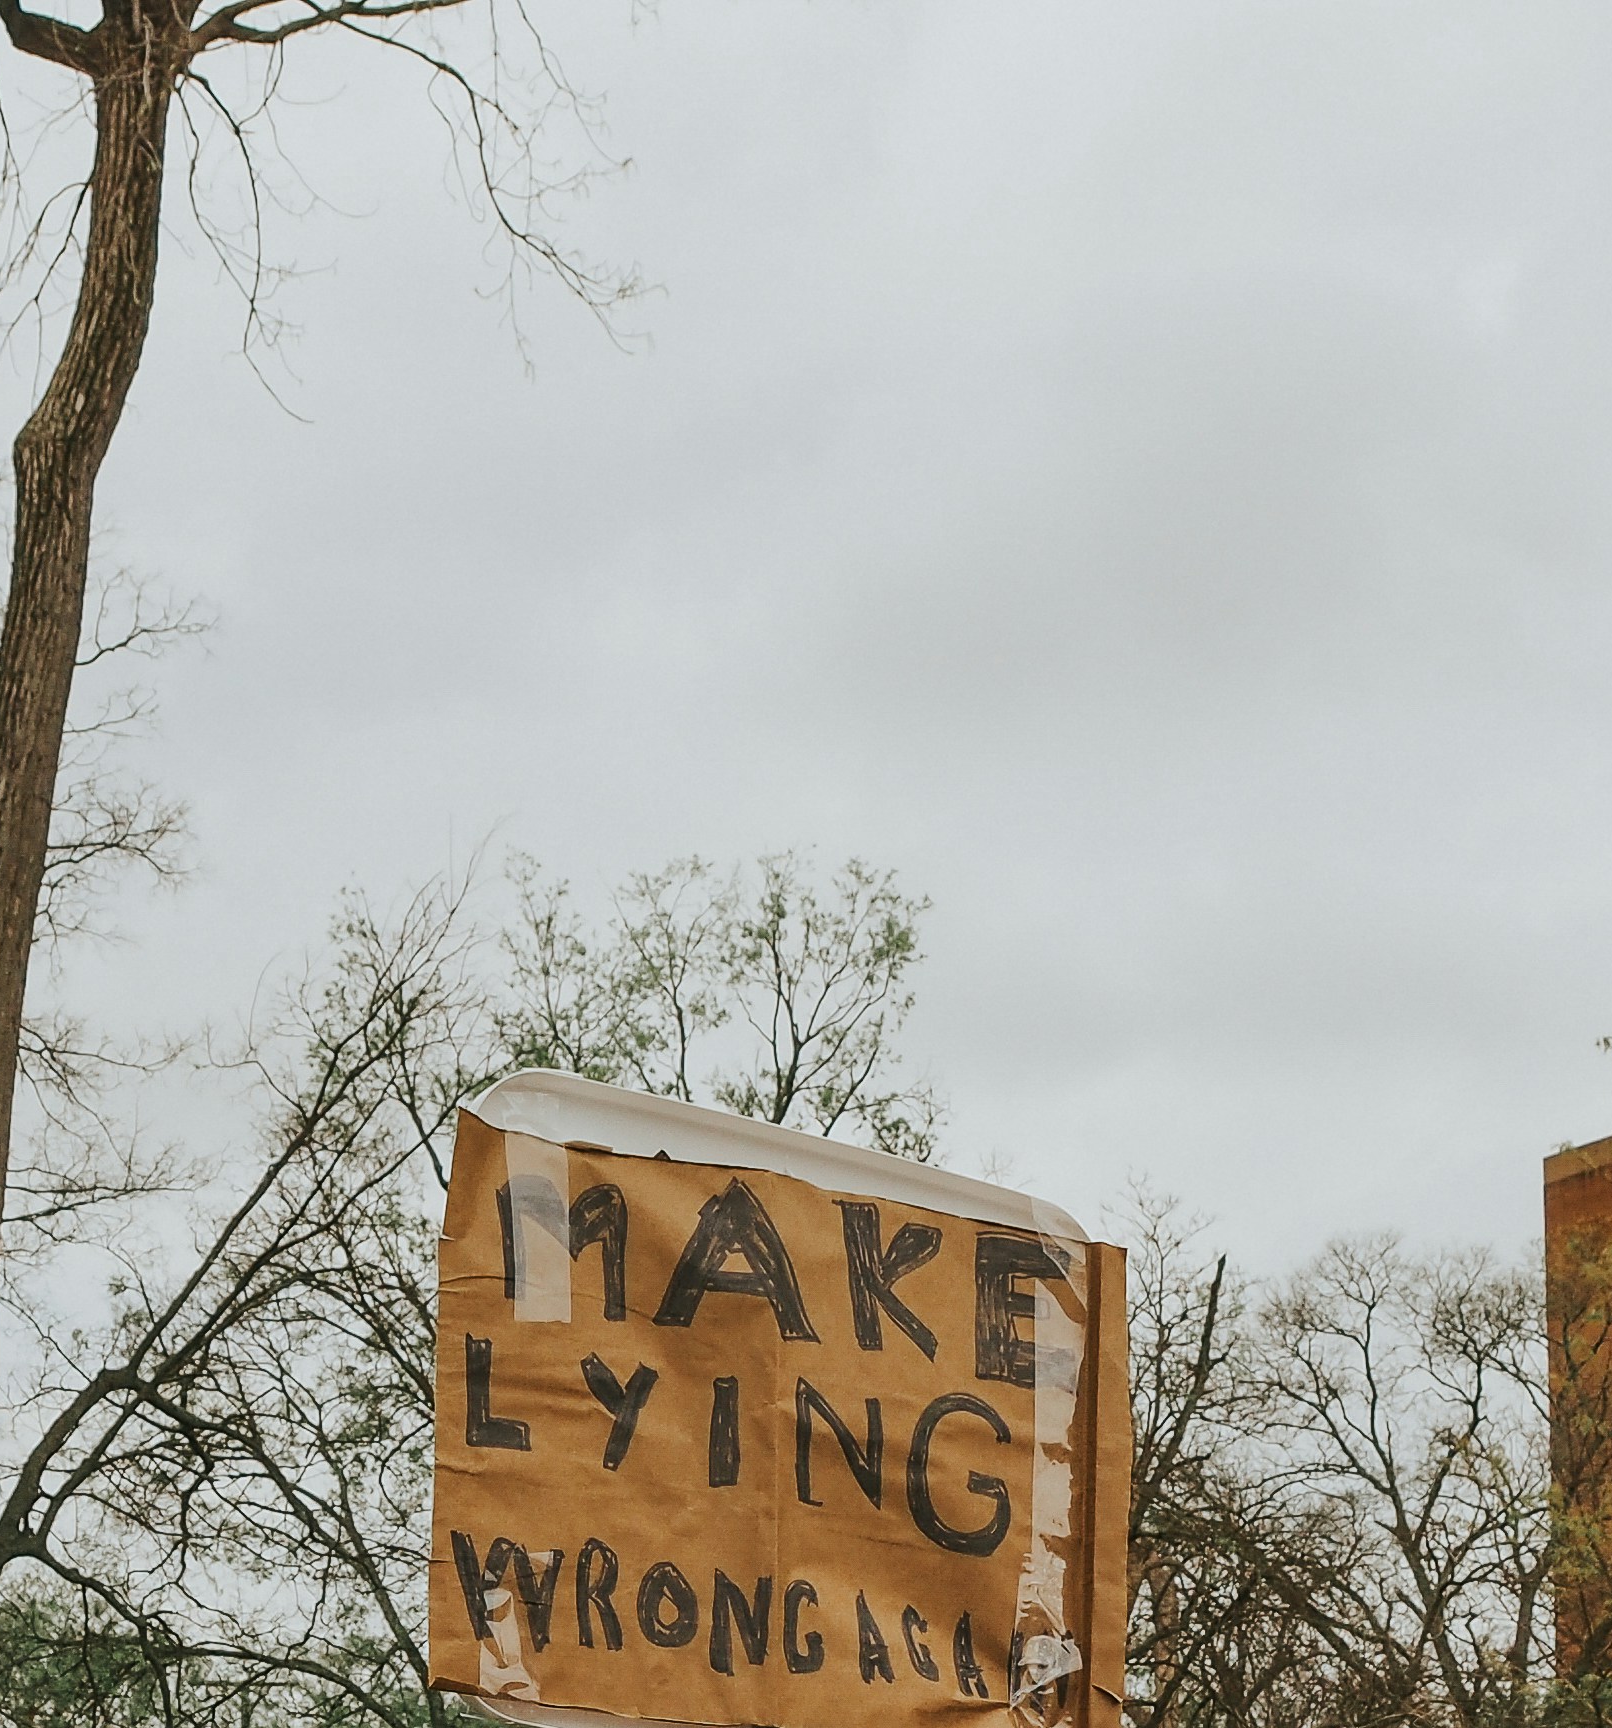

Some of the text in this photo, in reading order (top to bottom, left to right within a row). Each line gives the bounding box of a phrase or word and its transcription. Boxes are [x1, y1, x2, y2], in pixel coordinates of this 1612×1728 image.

[495, 1176, 1079, 1390] MAKE
[465, 1332, 1012, 1557] LYING
[449, 1530, 825, 1676] WRONG
